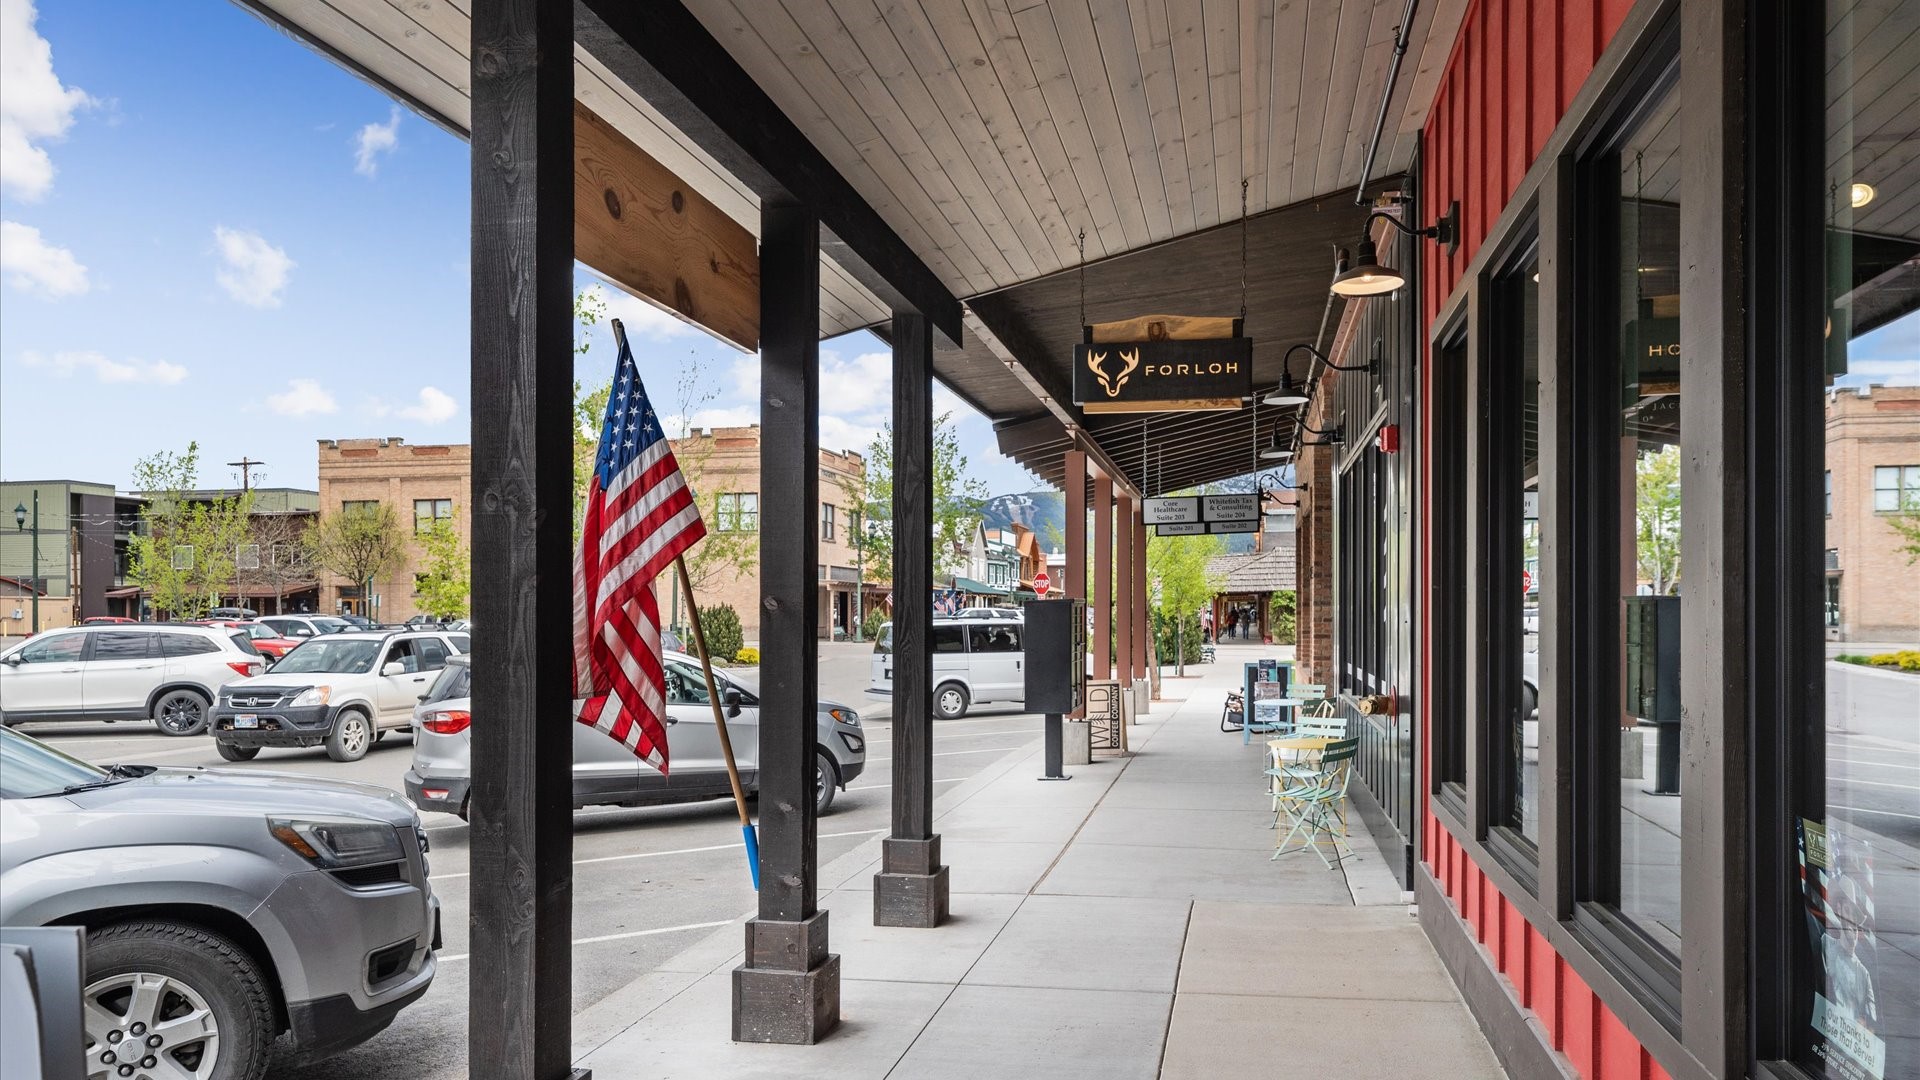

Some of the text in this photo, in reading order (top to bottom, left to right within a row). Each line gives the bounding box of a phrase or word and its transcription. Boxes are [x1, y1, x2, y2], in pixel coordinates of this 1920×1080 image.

[1145, 362, 1238, 376] FORLOH
[1217, 503, 1253, 511] Consulting
[1035, 579, 1049, 588] STOP
[1089, 688, 1110, 745] WILD
[1820, 1015, 1838, 1038] Those
[1839, 1029, 1853, 1049] that
[1853, 1041, 1875, 1067] Serve!
[1827, 1008, 1870, 1048] Our Thanks to
